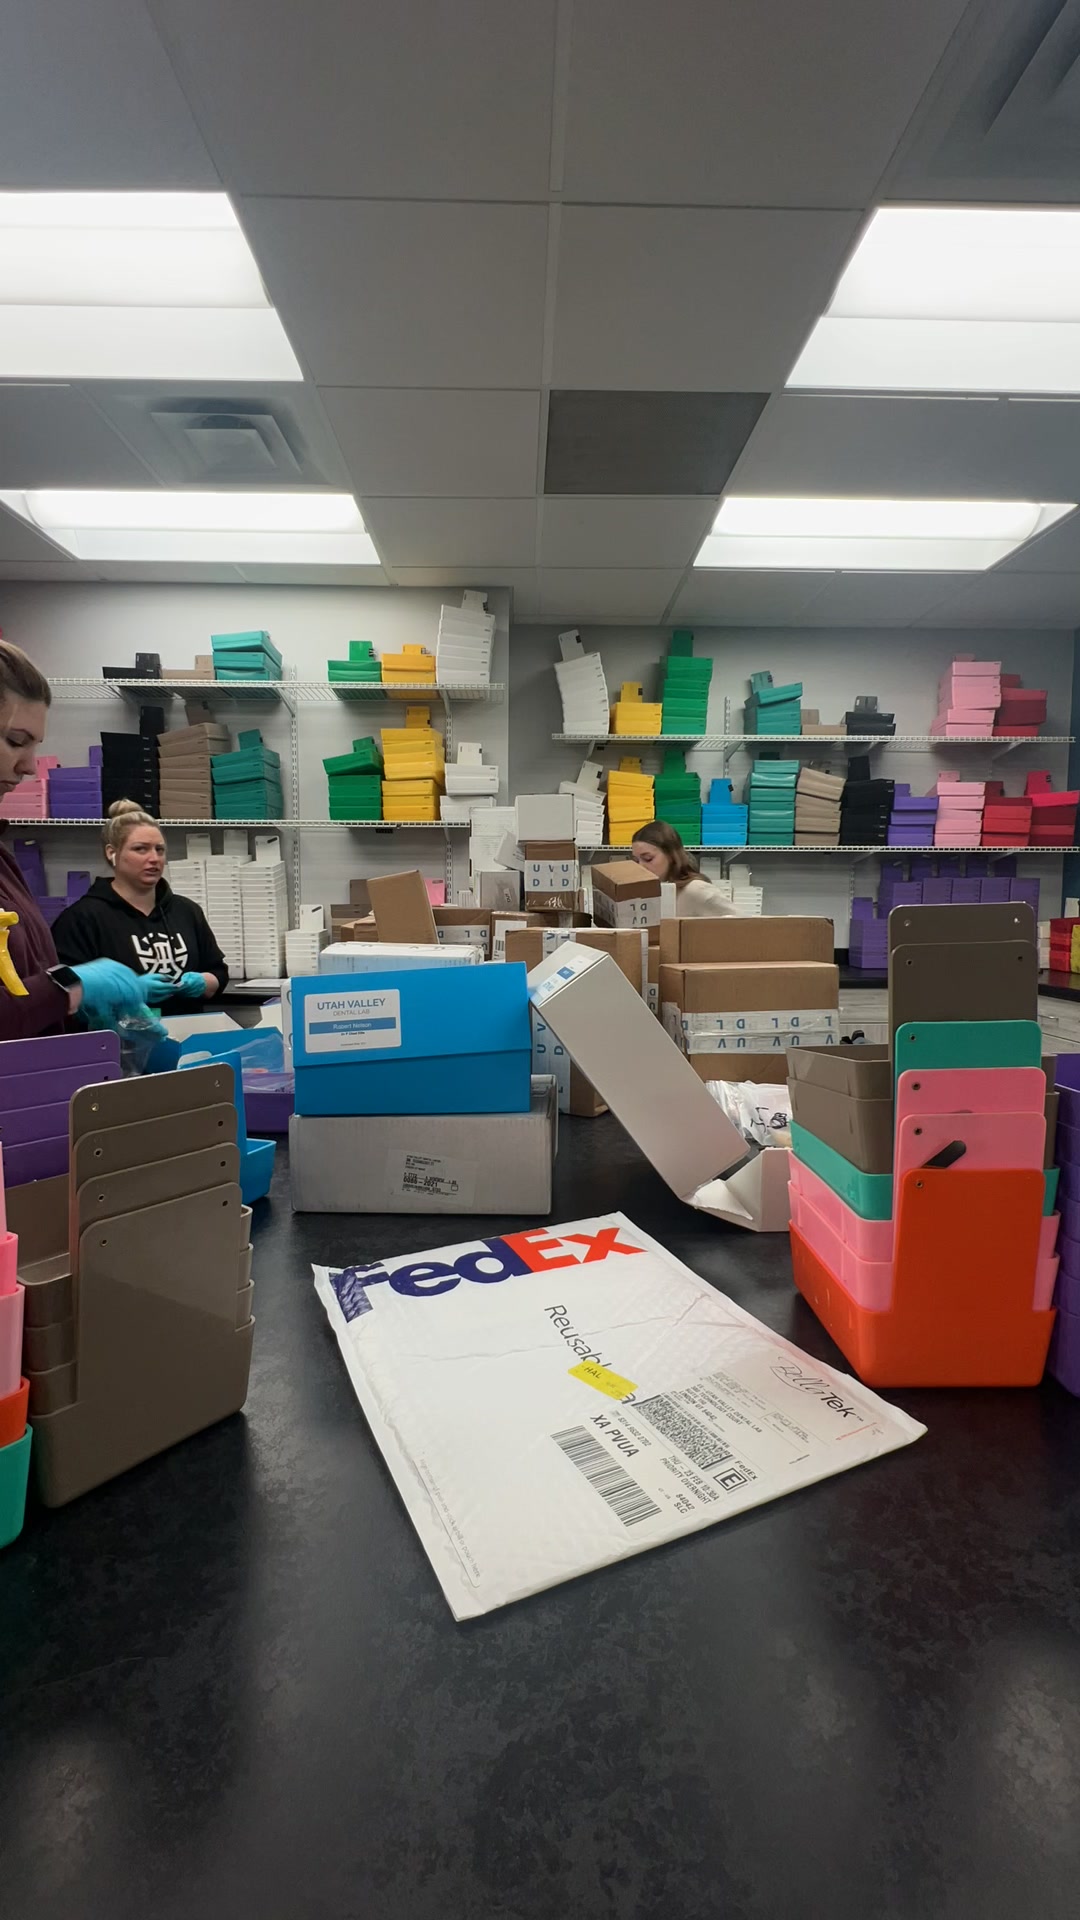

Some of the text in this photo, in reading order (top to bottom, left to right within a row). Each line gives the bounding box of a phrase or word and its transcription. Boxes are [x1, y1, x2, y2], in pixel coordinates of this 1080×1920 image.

[317, 998, 386, 1011] UTAH VALLEY
[333, 1009, 356, 1017] DENTAL
[329, 1227, 648, 1323] FedEx
[544, 1304, 612, 1368] Reusab
[590, 1413, 611, 1428] XA
[605, 1428, 639, 1458] PVUA
[734, 1460, 758, 1480] FedEx
[660, 1457, 683, 1478] PRIORITY
[681, 1477, 710, 1504] OVERNIGHT
[674, 1501, 687, 1514] SLC
[676, 1492, 694, 1510] 84042
